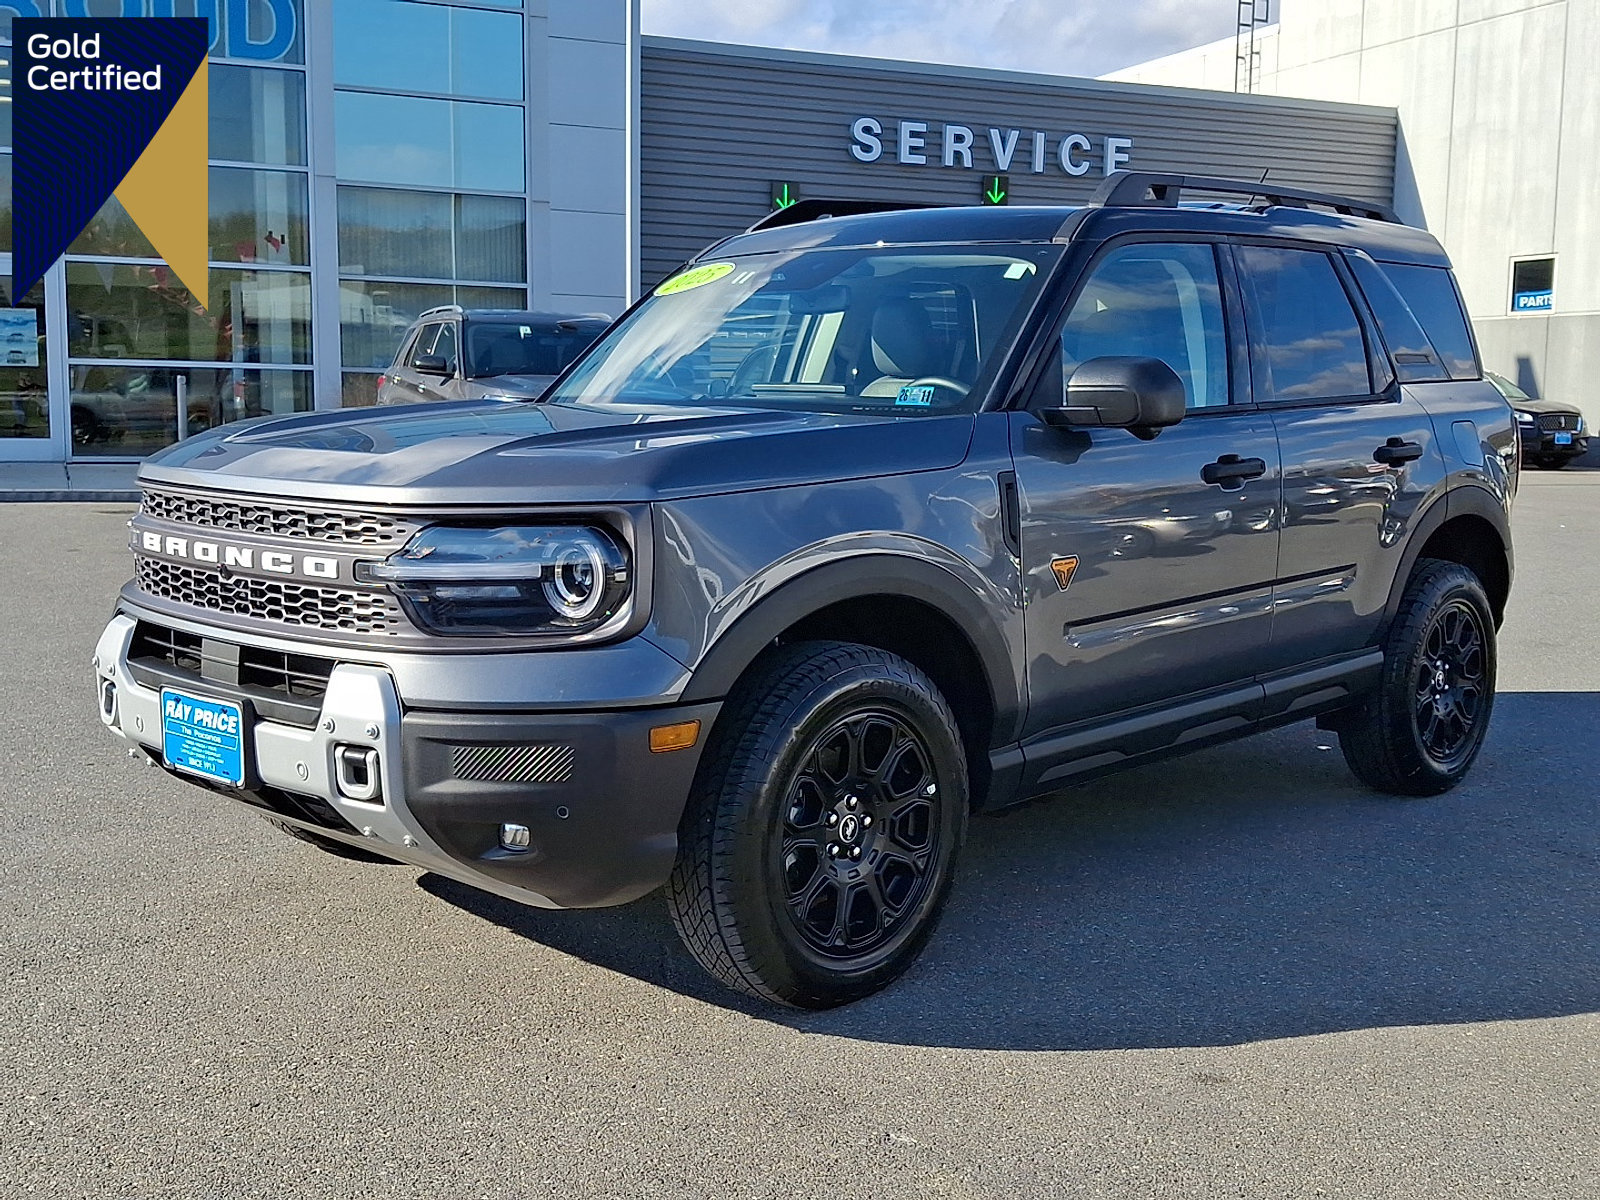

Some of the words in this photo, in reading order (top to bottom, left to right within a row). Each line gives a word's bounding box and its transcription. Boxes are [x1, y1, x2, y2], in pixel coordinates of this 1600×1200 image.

[850, 116, 1133, 178] SERVICE
[143, 531, 339, 579] BRONCO
[165, 700, 192, 721] RAY
[193, 707, 238, 734] PRICE
